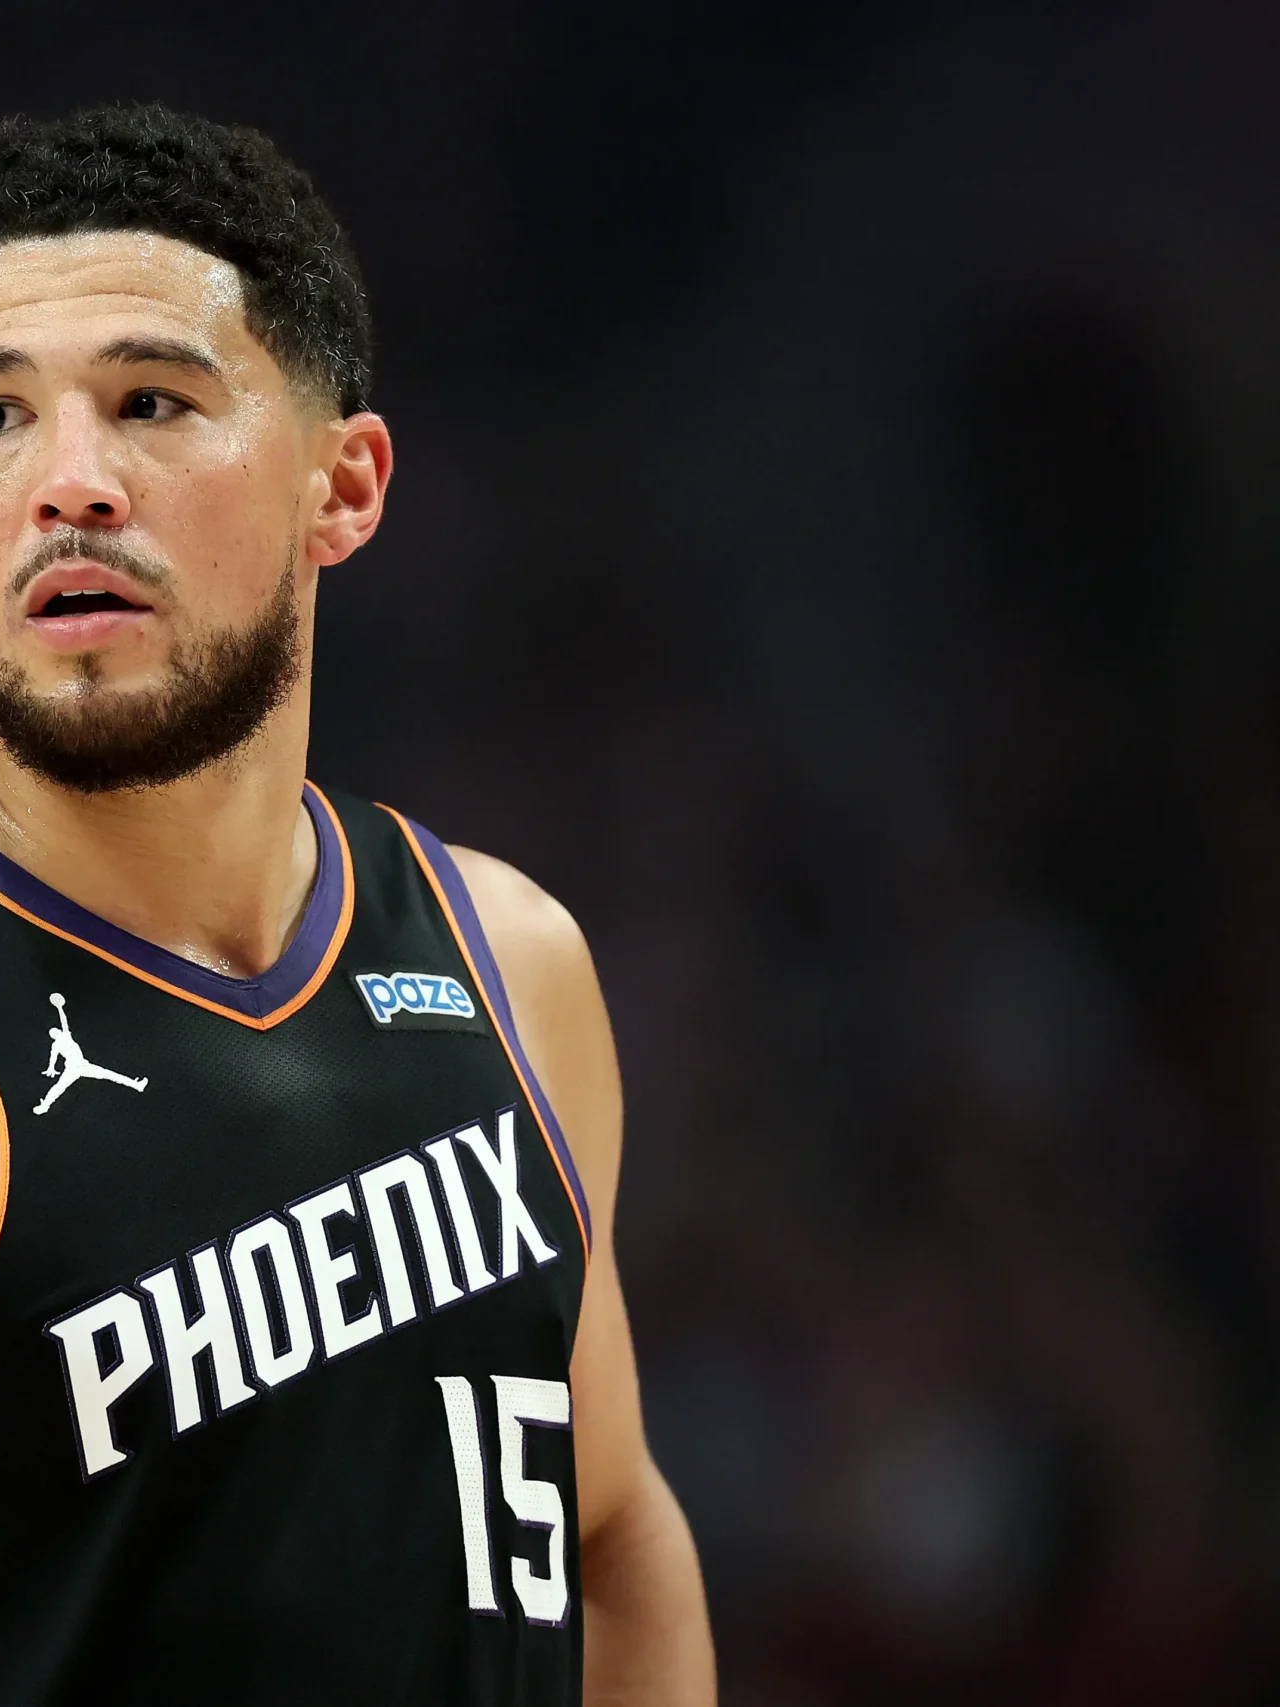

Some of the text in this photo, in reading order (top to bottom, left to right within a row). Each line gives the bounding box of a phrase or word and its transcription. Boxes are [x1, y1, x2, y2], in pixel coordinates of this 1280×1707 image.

[361, 977, 471, 1018] paze
[46, 1107, 559, 1478] PHOENIX
[434, 1374, 570, 1624] 15
